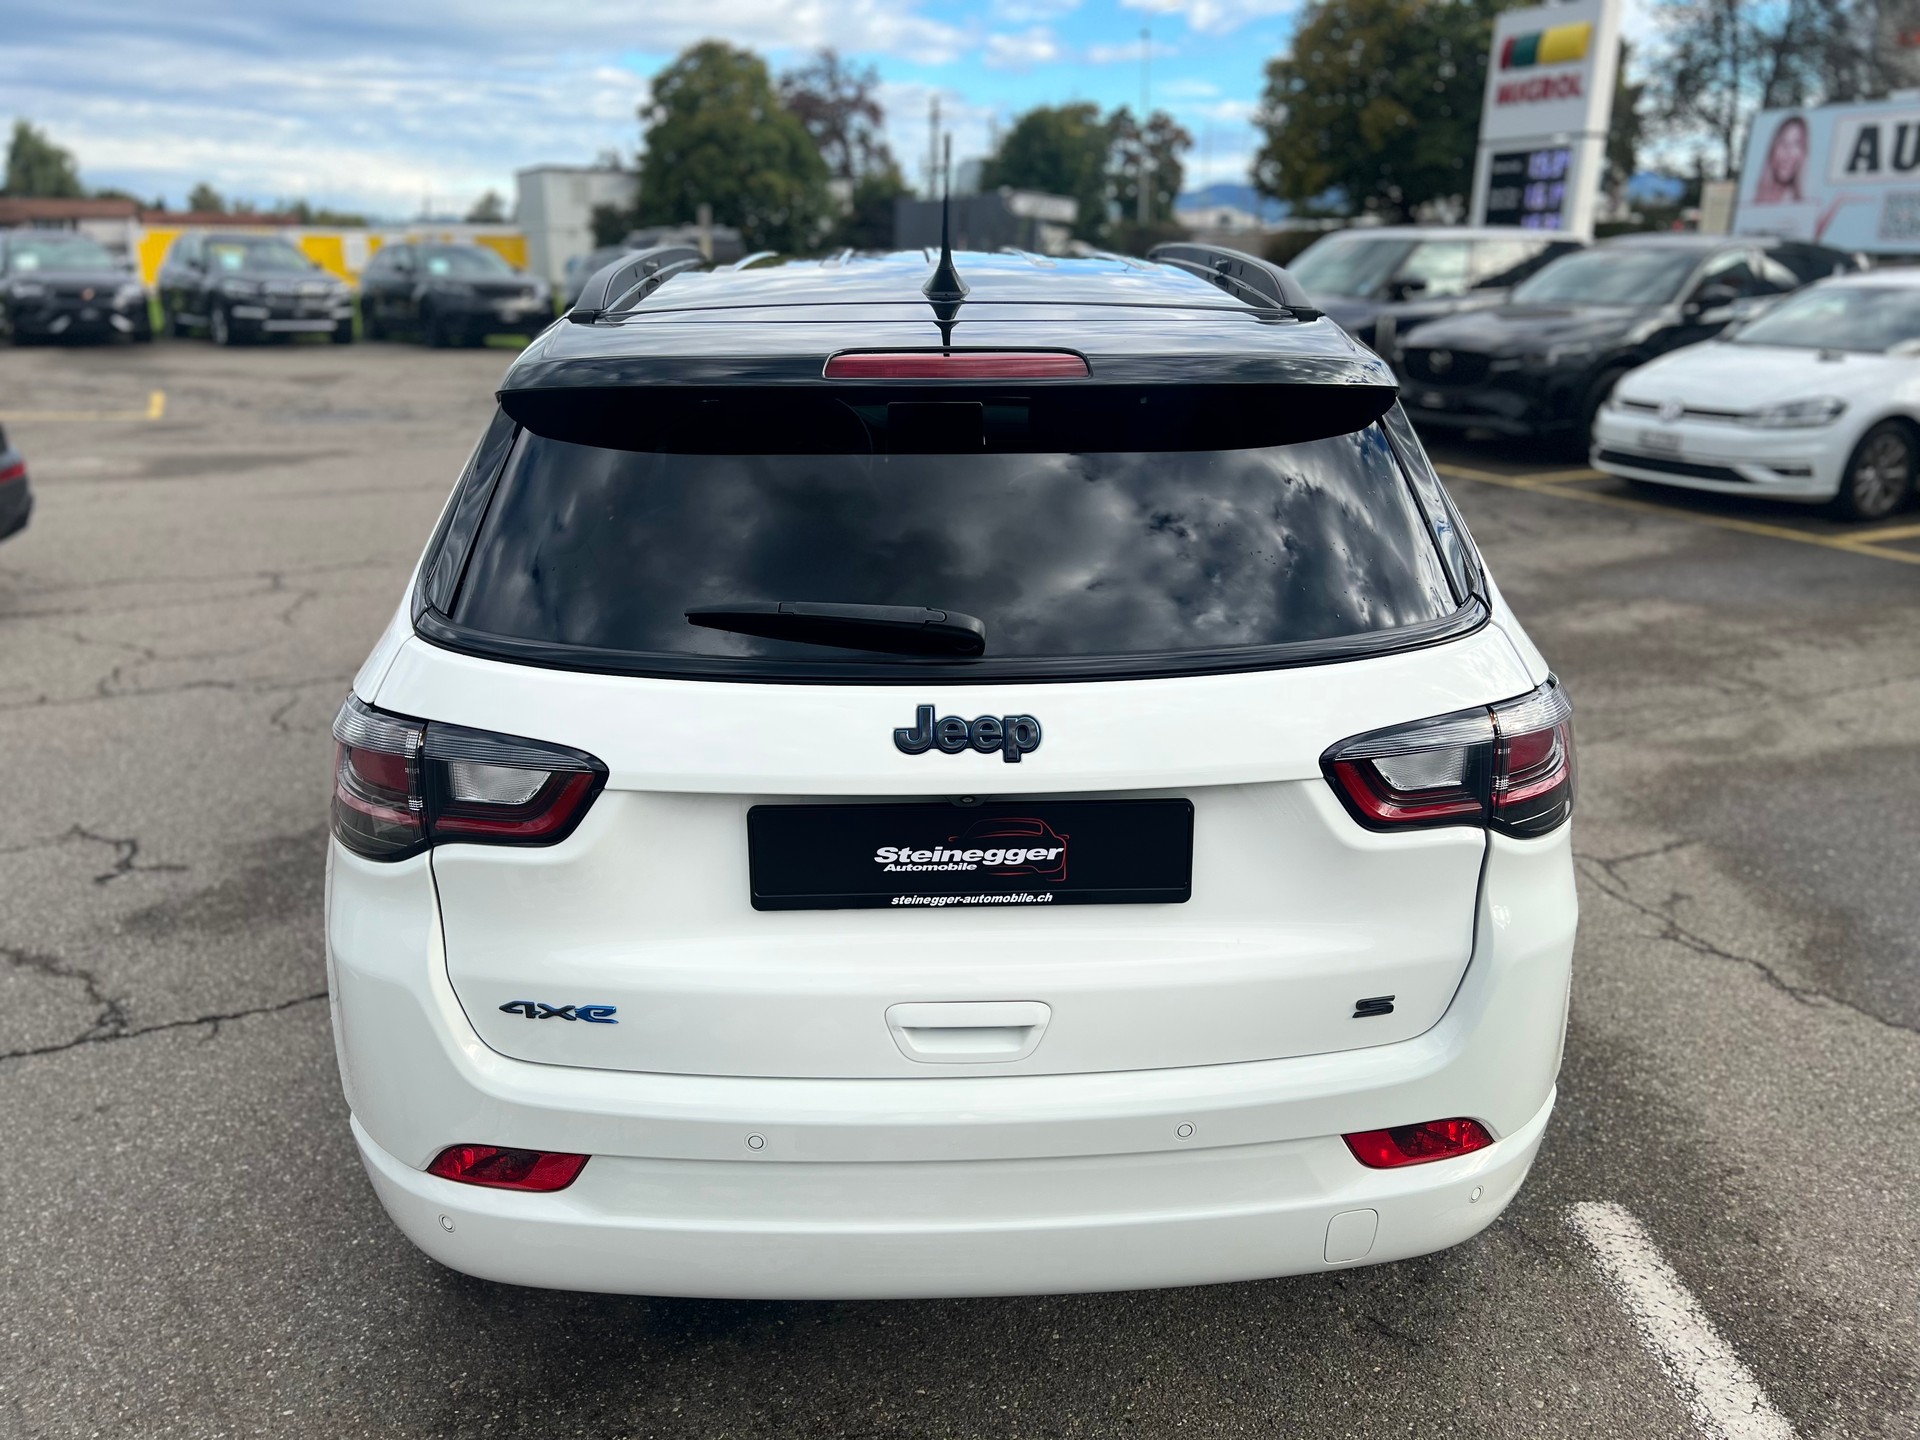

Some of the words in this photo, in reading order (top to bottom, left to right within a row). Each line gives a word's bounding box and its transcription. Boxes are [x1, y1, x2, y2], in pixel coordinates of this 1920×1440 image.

[894, 704, 1042, 763] Jeep
[874, 846, 1064, 866] Steinegger
[883, 862, 978, 872] Automobile
[891, 893, 1053, 907] steinegger-automobile.ch
[1352, 994, 1395, 1019] S
